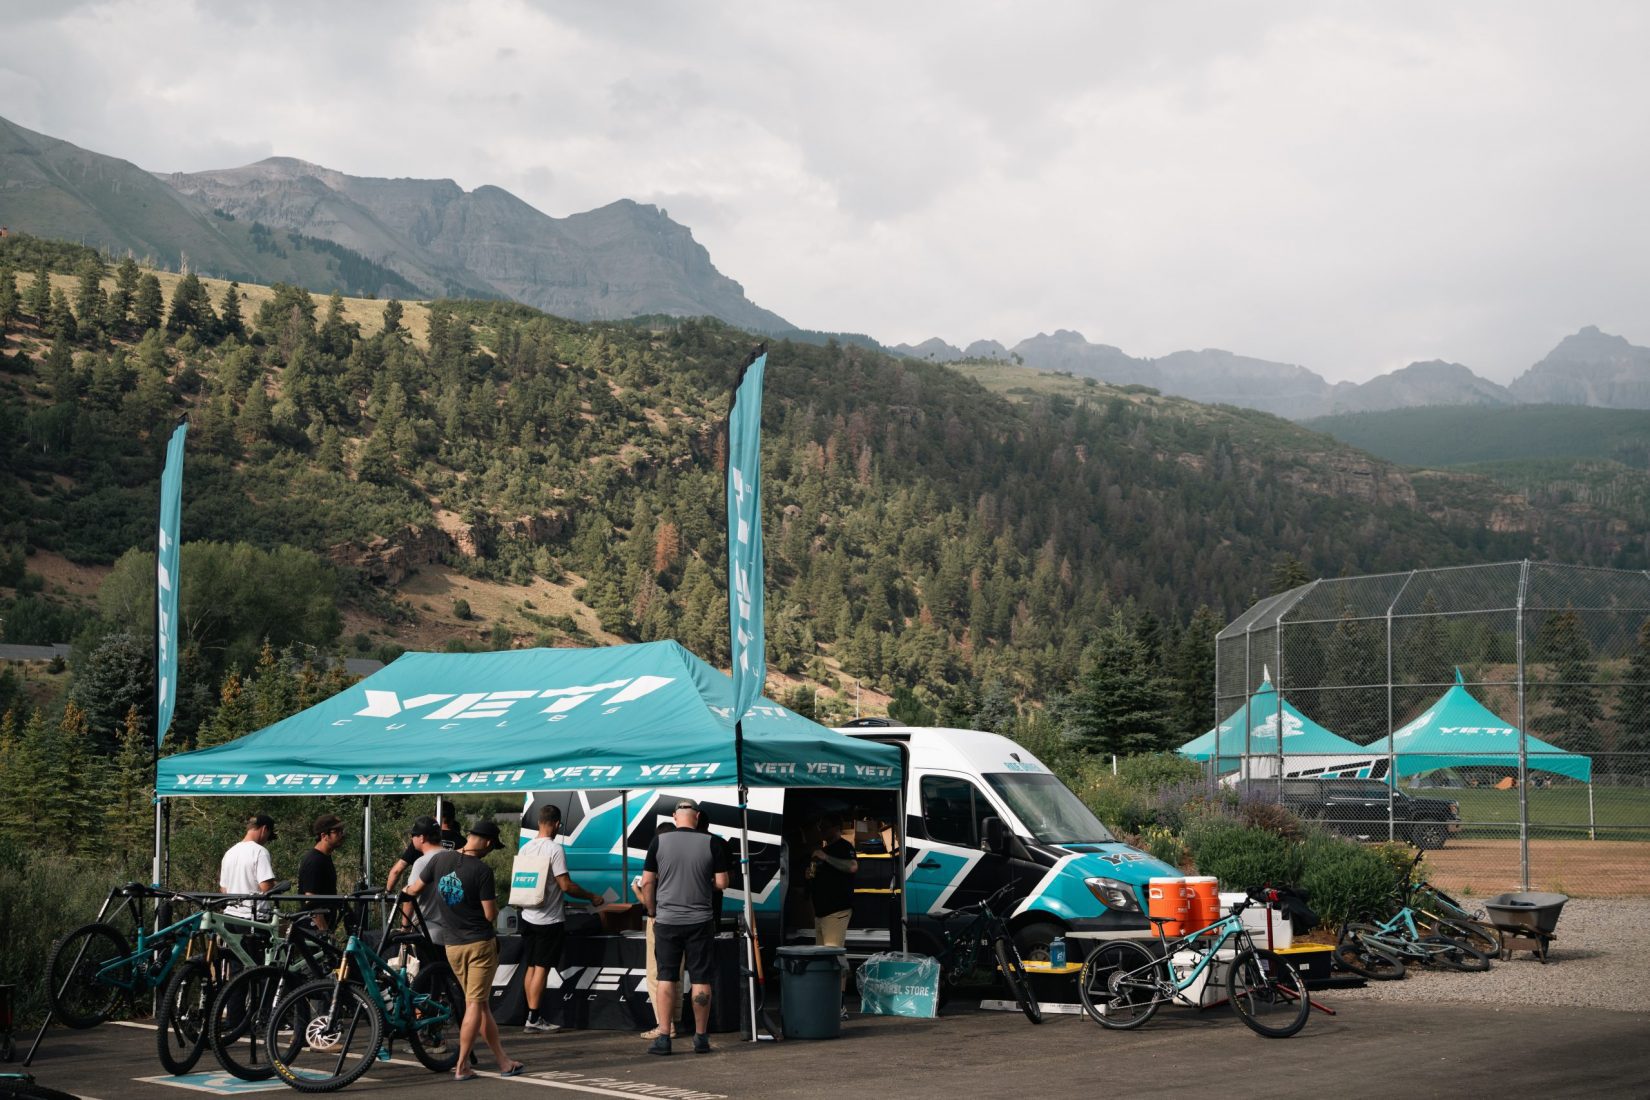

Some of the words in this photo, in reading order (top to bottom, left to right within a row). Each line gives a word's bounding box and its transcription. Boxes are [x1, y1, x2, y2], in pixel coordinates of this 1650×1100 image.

[353, 675, 676, 720] YETI
[1439, 727, 1513, 735] YETI
[176, 774, 248, 785] YETI
[264, 773, 339, 785] YETI
[355, 773, 430, 785] YETI
[447, 769, 526, 783] YETI
[543, 765, 623, 779] YETI
[639, 762, 721, 777] YETI
[753, 762, 796, 774] YETI
[806, 762, 846, 774] YETI
[854, 765, 894, 777] YETI
[1098, 853, 1145, 866] YE
[546, 966, 692, 993] YET
[905, 985, 929, 997] STORE
